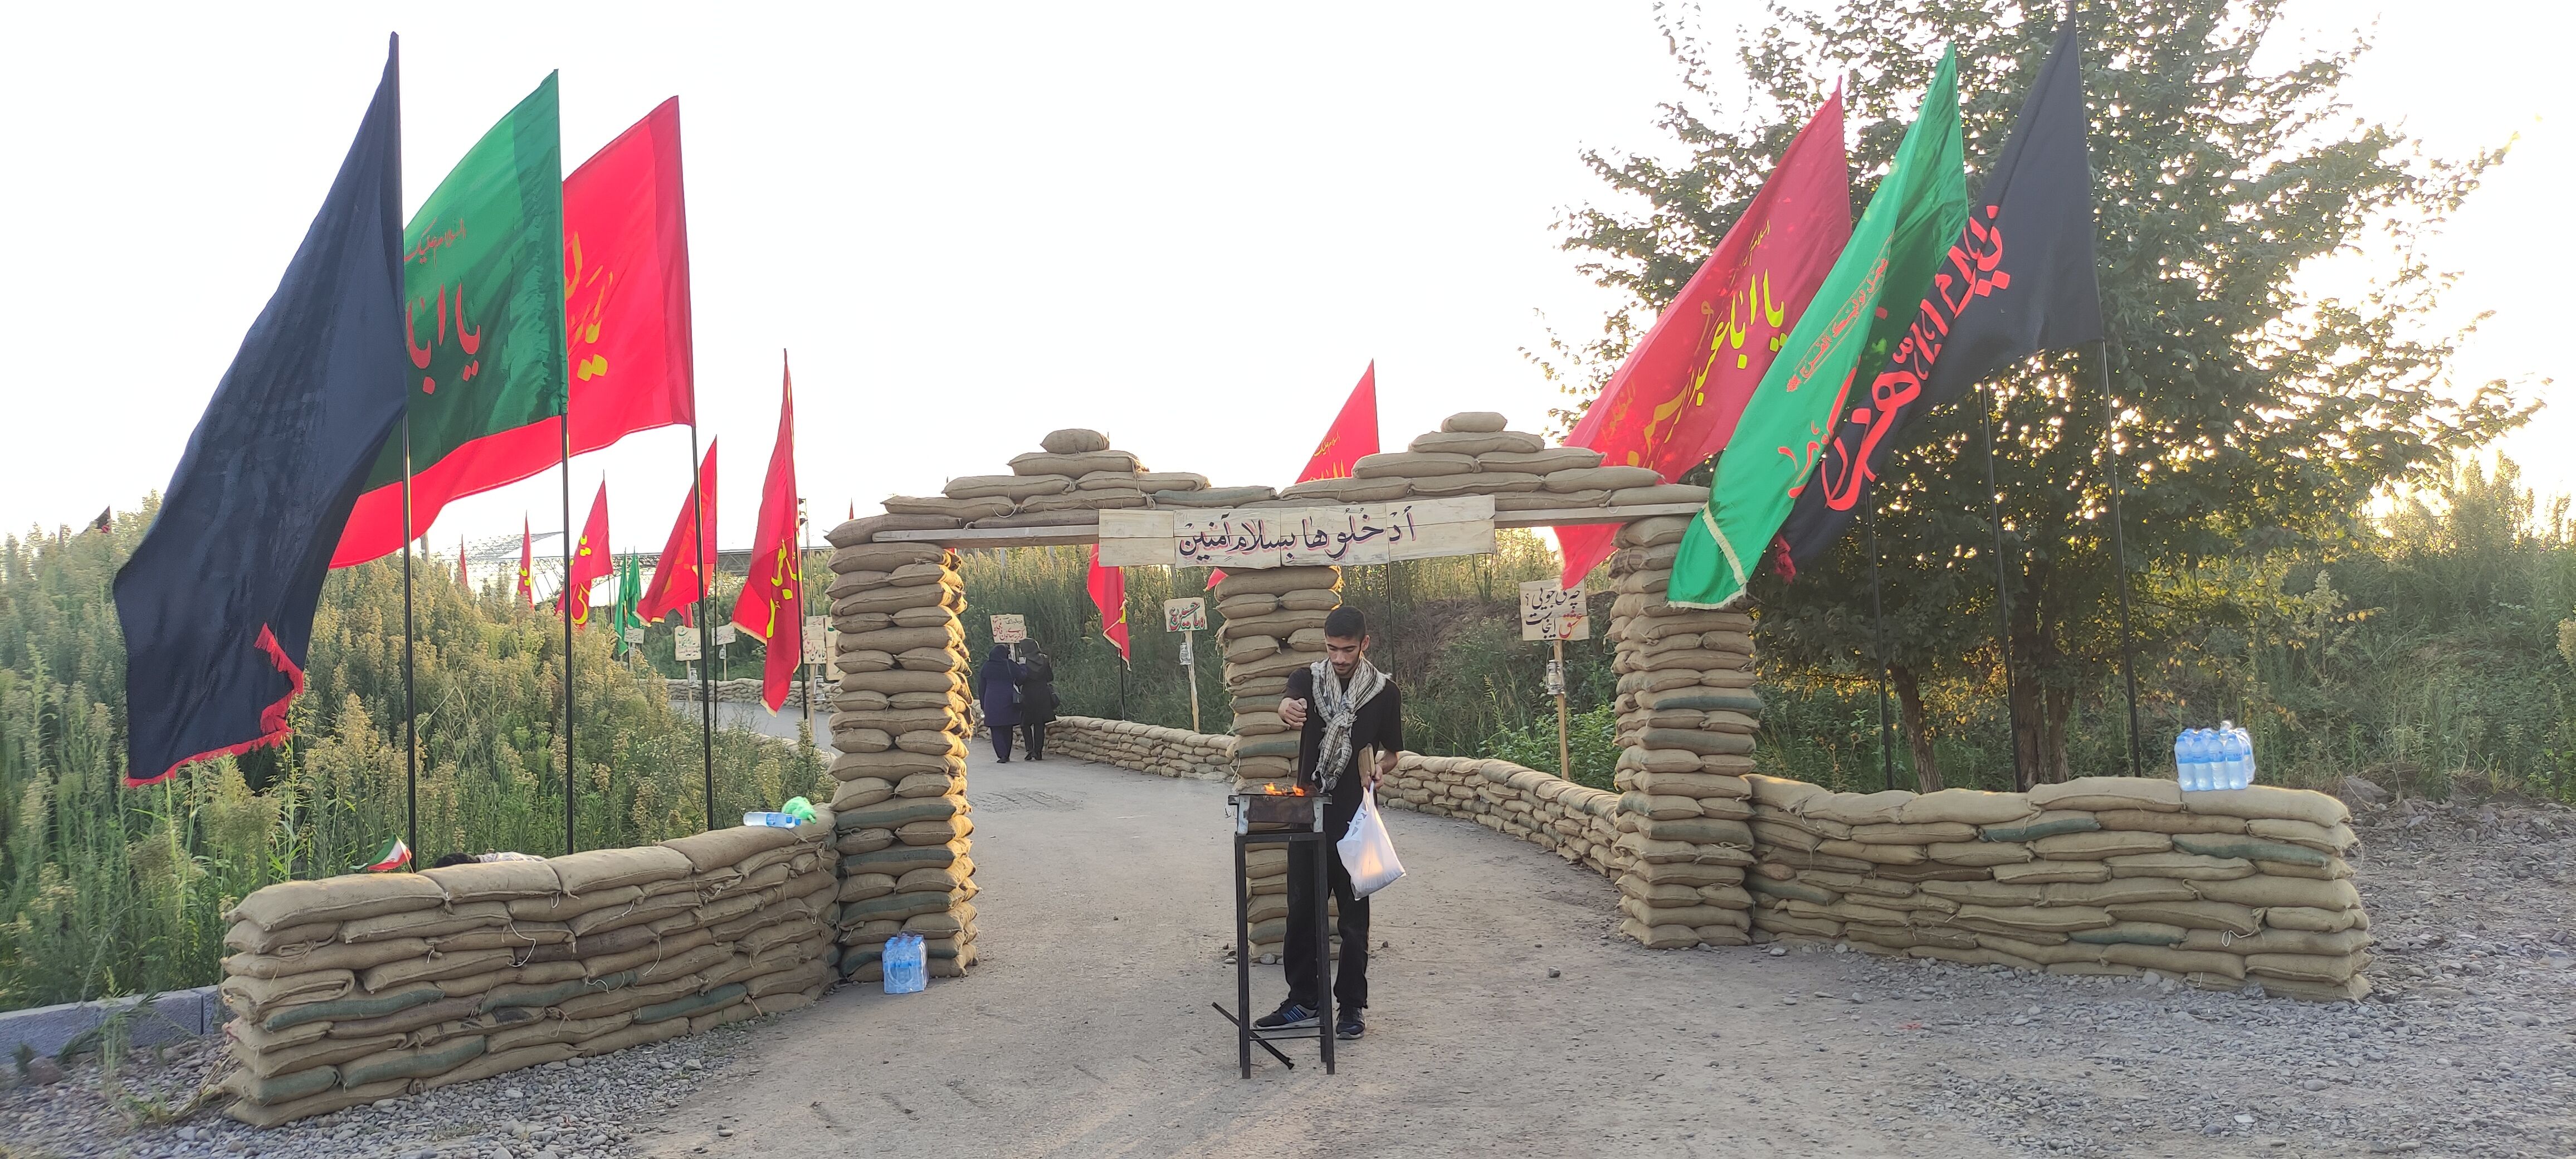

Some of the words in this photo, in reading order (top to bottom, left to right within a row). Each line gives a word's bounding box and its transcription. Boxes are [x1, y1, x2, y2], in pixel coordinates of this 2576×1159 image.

[455, 281, 481, 382] یا
[1763, 269, 1788, 352] یا
[1559, 610, 1583, 639] عشق
[1569, 590, 1581, 609] چه
